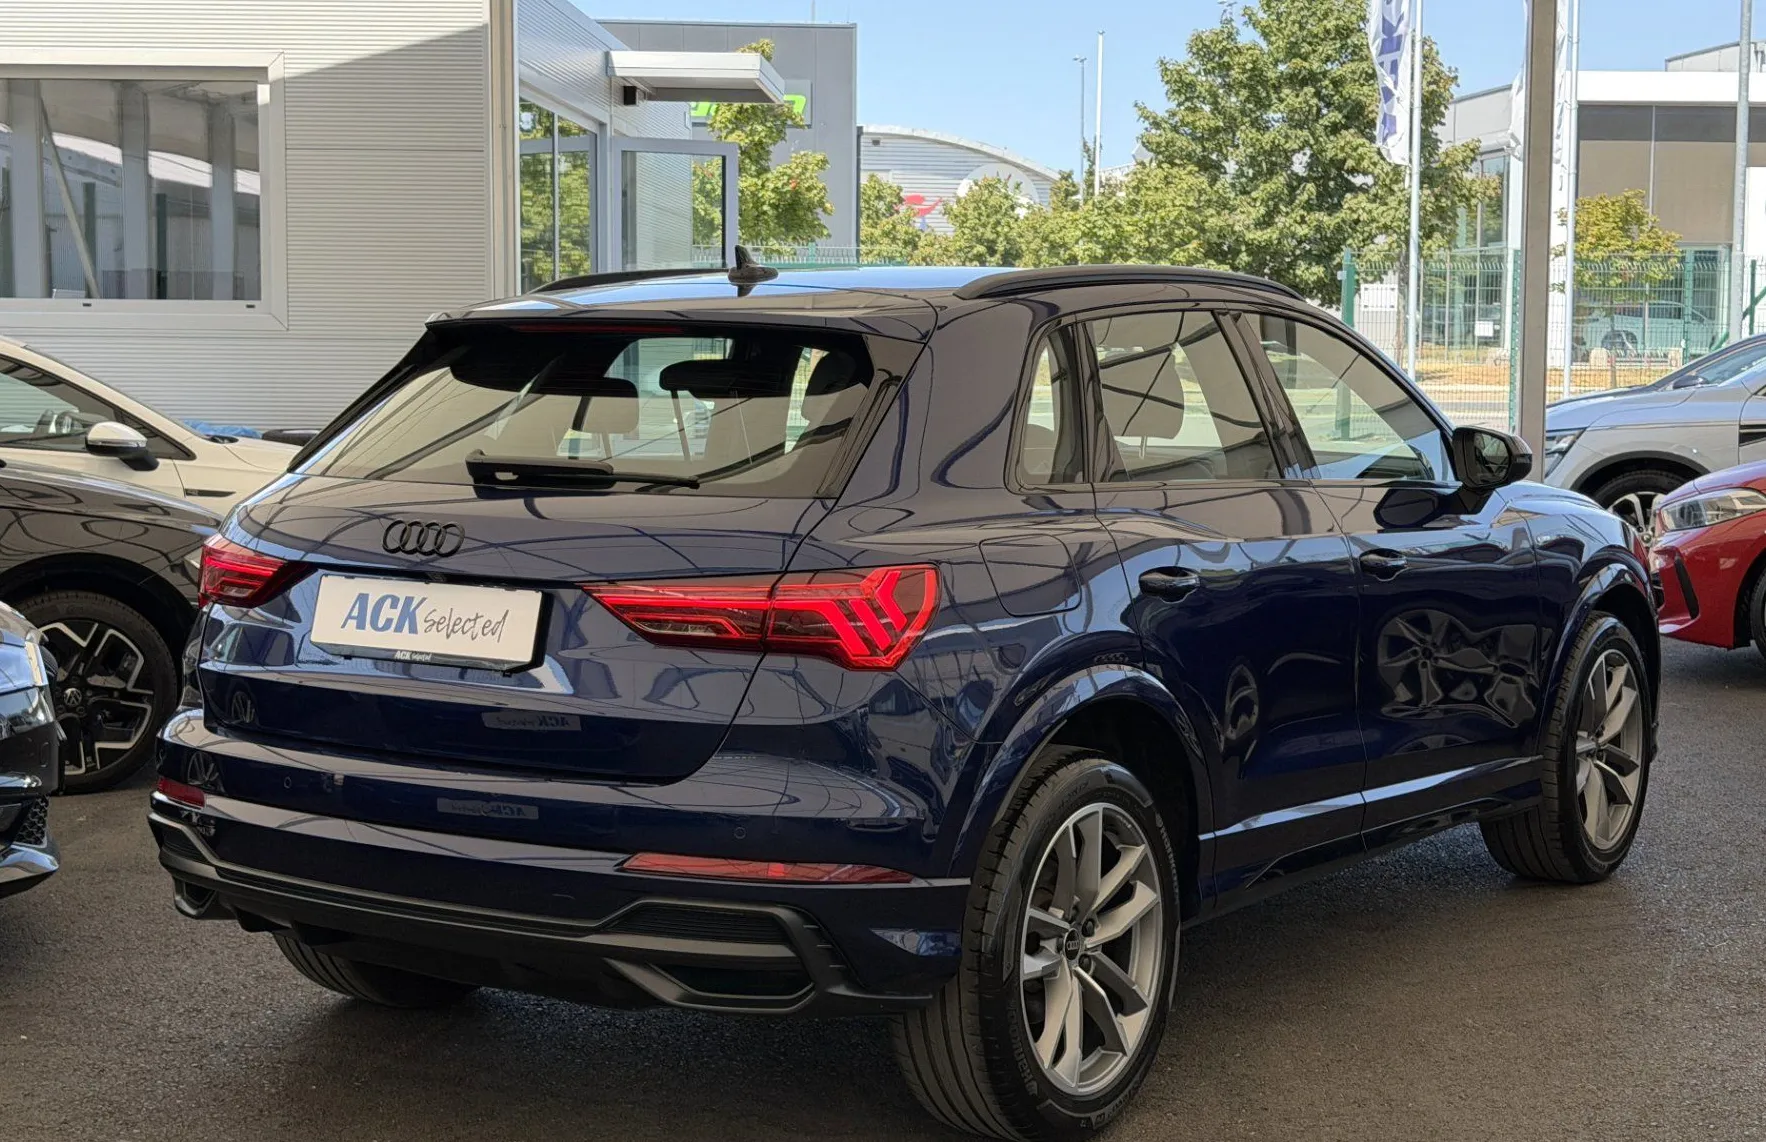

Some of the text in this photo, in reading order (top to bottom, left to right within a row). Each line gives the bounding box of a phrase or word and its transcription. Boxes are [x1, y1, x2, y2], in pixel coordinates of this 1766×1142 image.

[341, 592, 510, 643] ACK Selected
[394, 650, 411, 660] ACK
